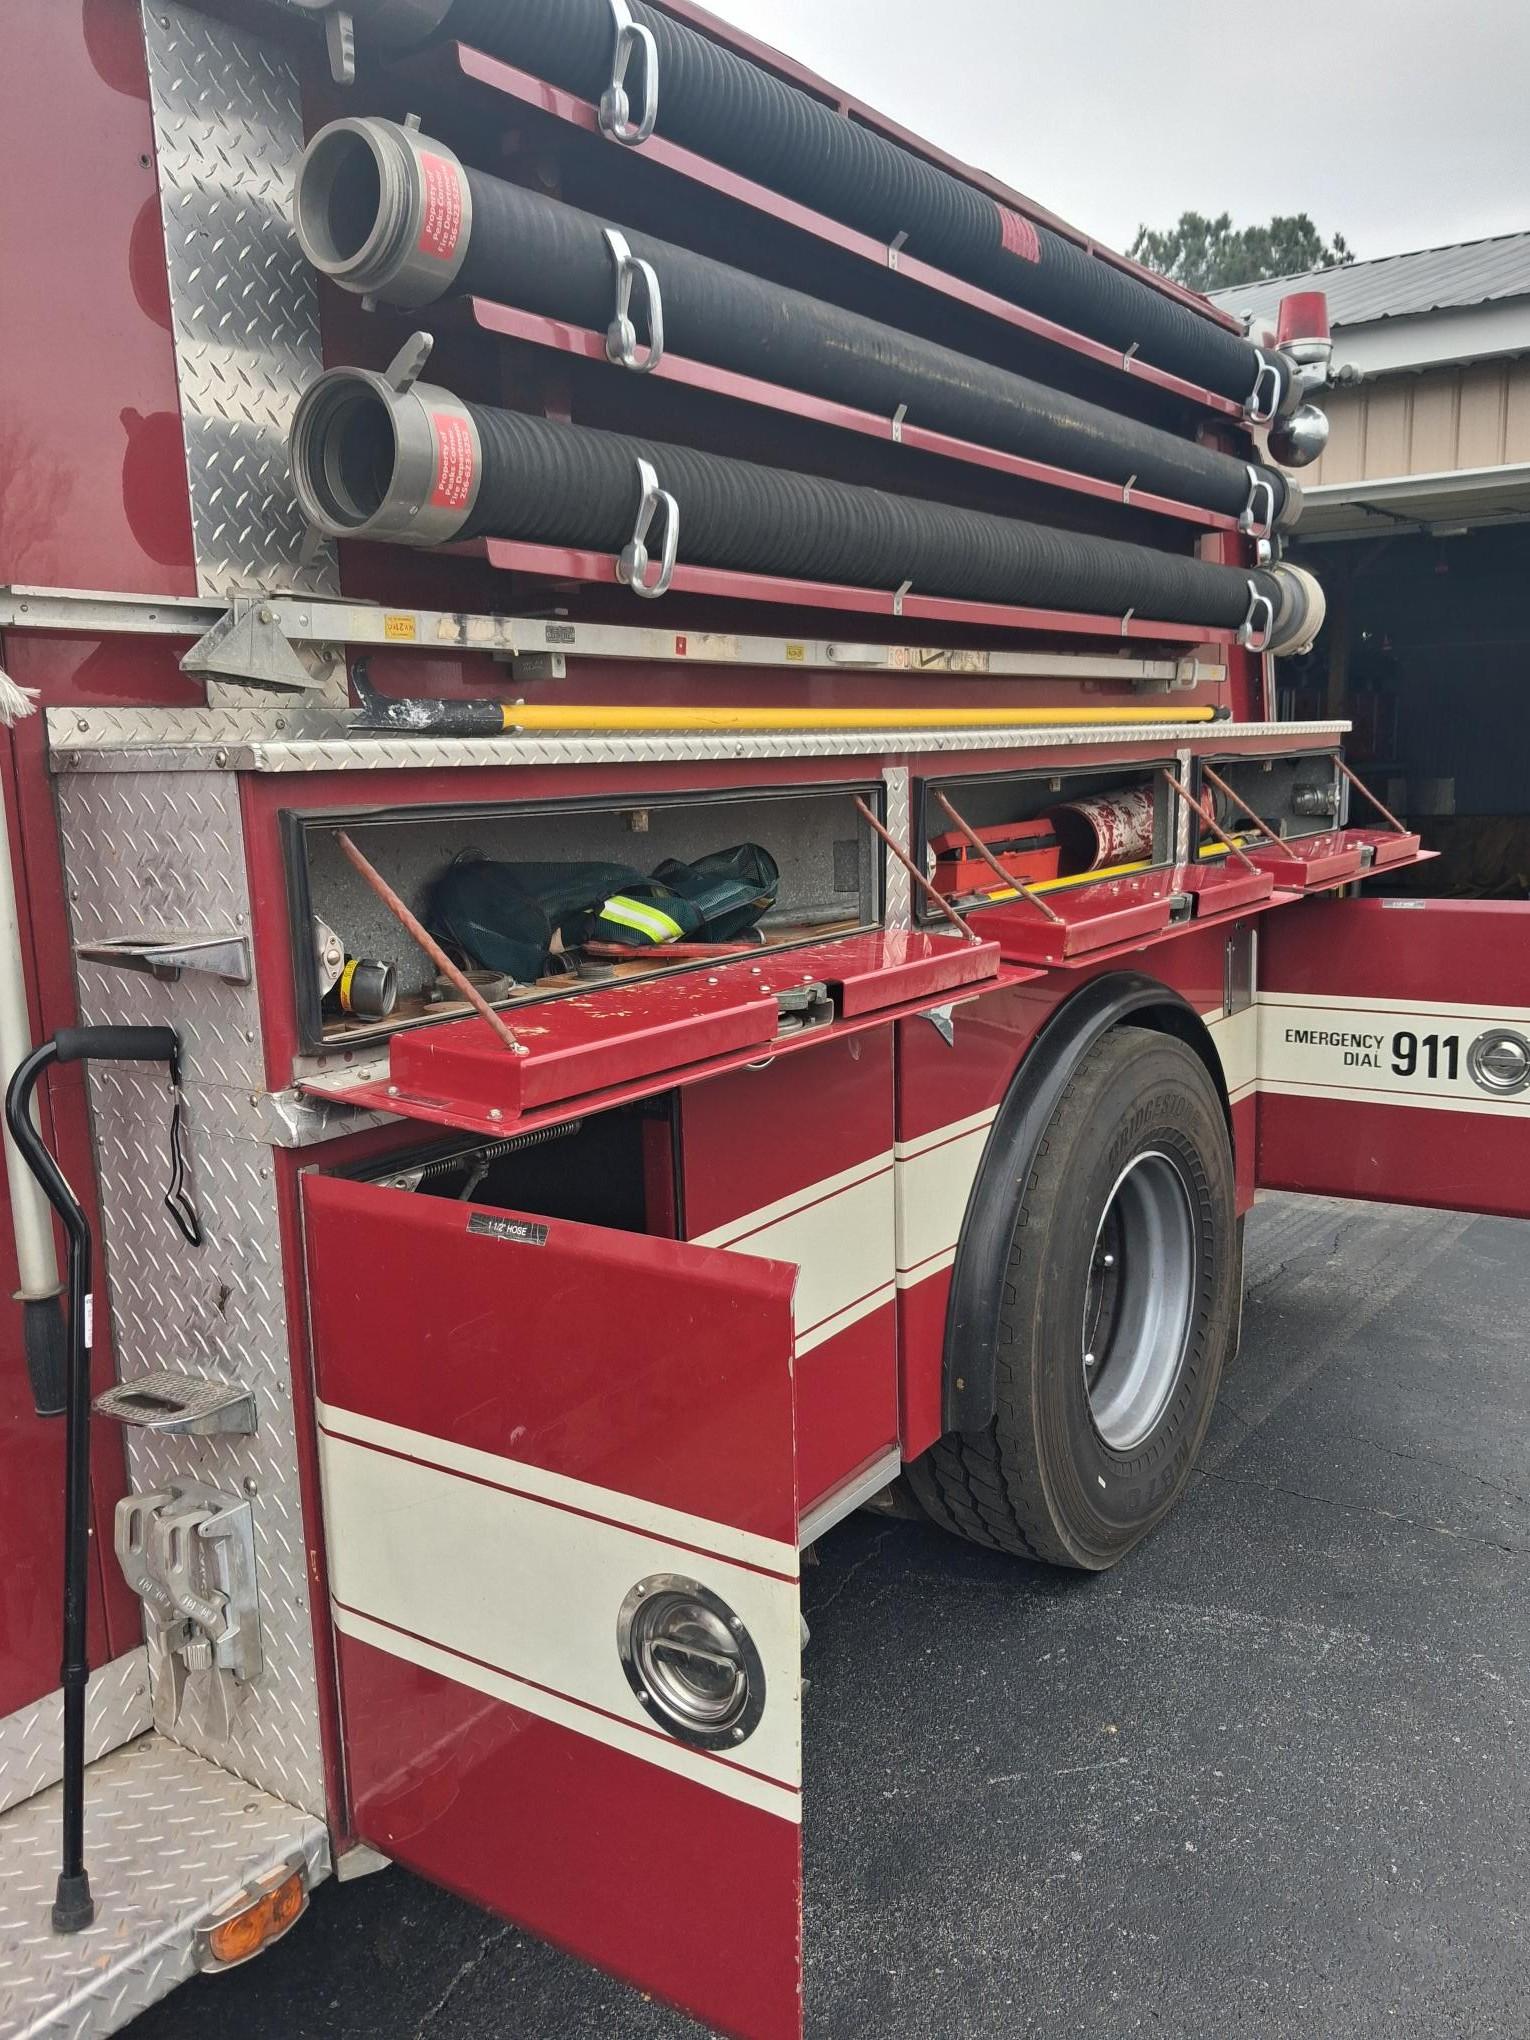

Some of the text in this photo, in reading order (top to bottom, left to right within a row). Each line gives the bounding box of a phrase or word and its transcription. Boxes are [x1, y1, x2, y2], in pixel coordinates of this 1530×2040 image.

[426, 186, 437, 233] Property
[433, 208, 443, 241] Peaks
[438, 232, 448, 252] Fire
[439, 445, 449, 490] Property
[445, 465, 456, 496] Peaks
[450, 486, 460, 505] Fire
[1285, 1029, 1460, 1080] EMERGENCY 911
[1344, 1052, 1382, 1068] DIAL
[1108, 1093, 1202, 1165] BRIDGESTONE
[506, 1225, 528, 1236] HOSE
